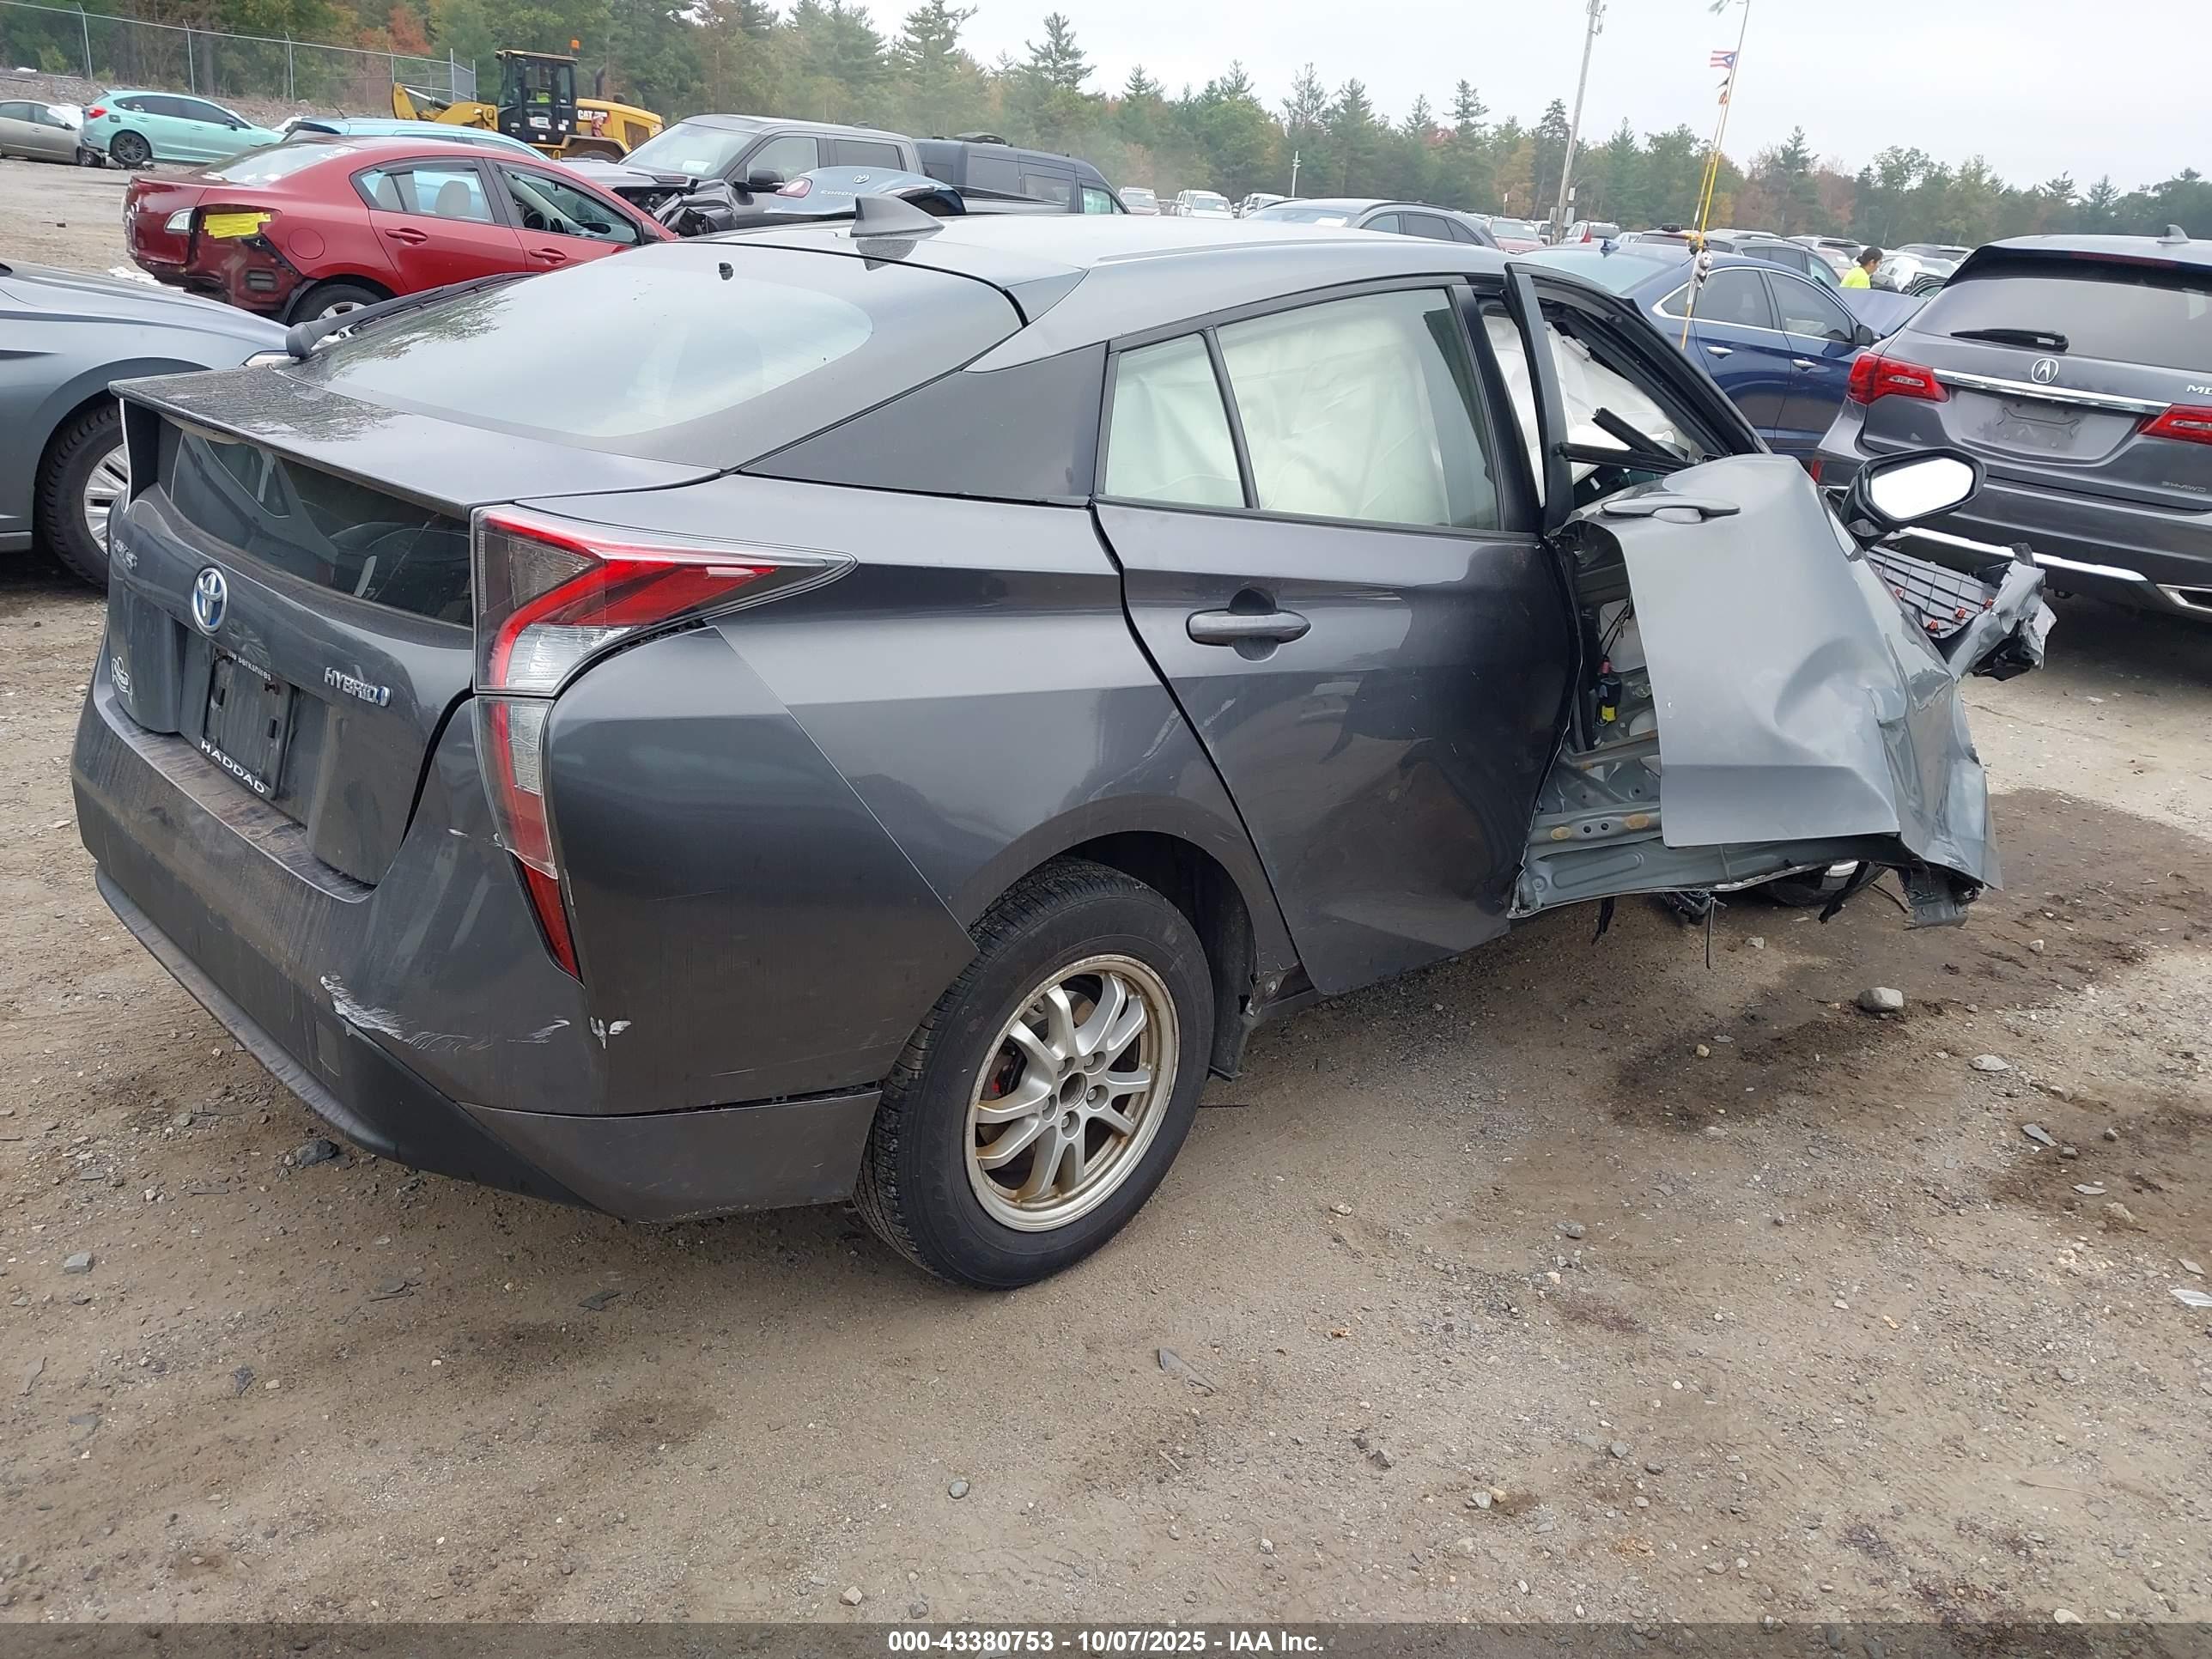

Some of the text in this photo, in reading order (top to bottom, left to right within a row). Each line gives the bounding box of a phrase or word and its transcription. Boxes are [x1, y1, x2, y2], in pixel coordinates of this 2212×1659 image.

[577, 110, 593, 121] CAT
[324, 666, 379, 704] HYBRID
[200, 740, 265, 793] HADDAD
